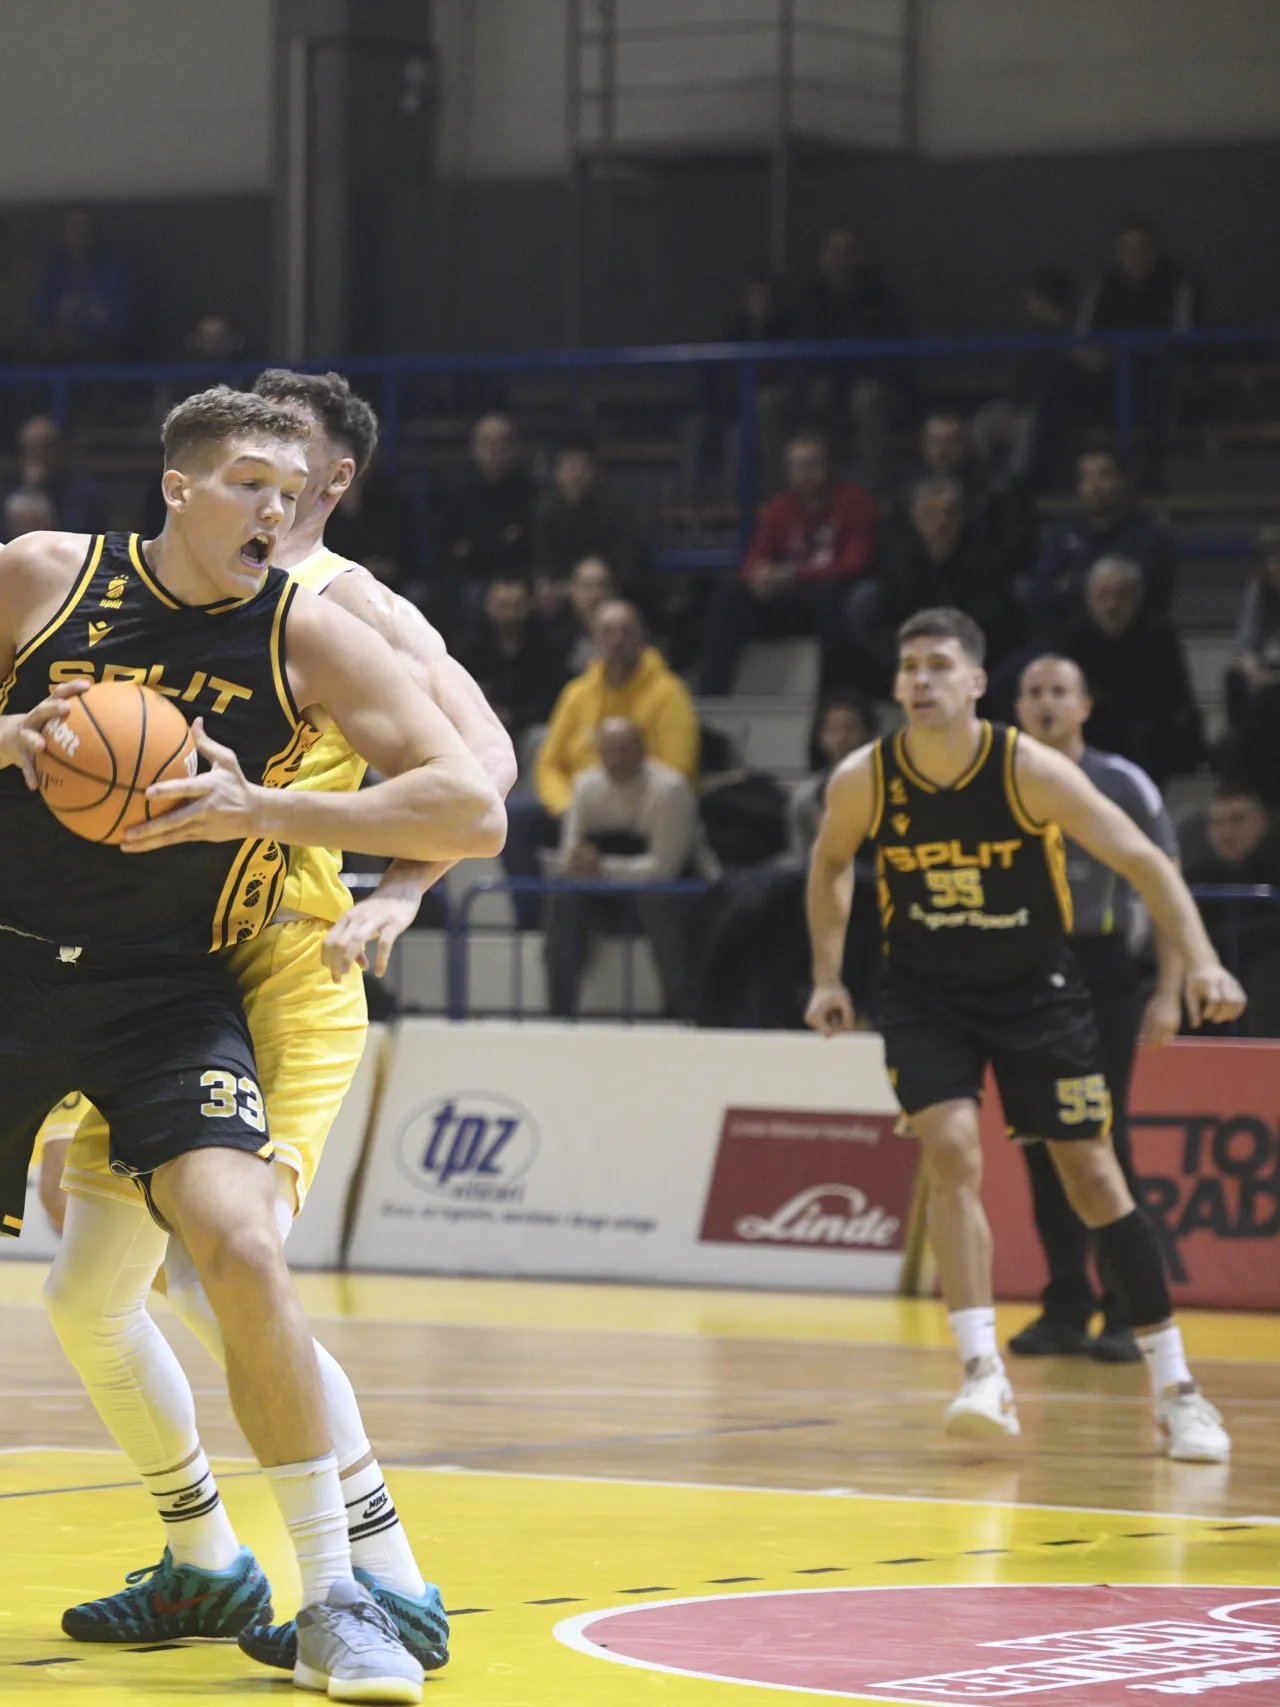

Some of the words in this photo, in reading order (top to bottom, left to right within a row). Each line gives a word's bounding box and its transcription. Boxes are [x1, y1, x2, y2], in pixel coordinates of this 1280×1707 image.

[49, 660, 254, 714] SPLIT
[884, 839, 1022, 872] SPLIT
[926, 868, 984, 908] 55
[200, 1069, 266, 1133] 33
[1055, 1073, 1108, 1125] 55
[421, 1099, 520, 1186] tpz
[1128, 1115, 1280, 1178] TO
[734, 1183, 901, 1246] Linde
[880, 1634, 1280, 1694] REMIJER
